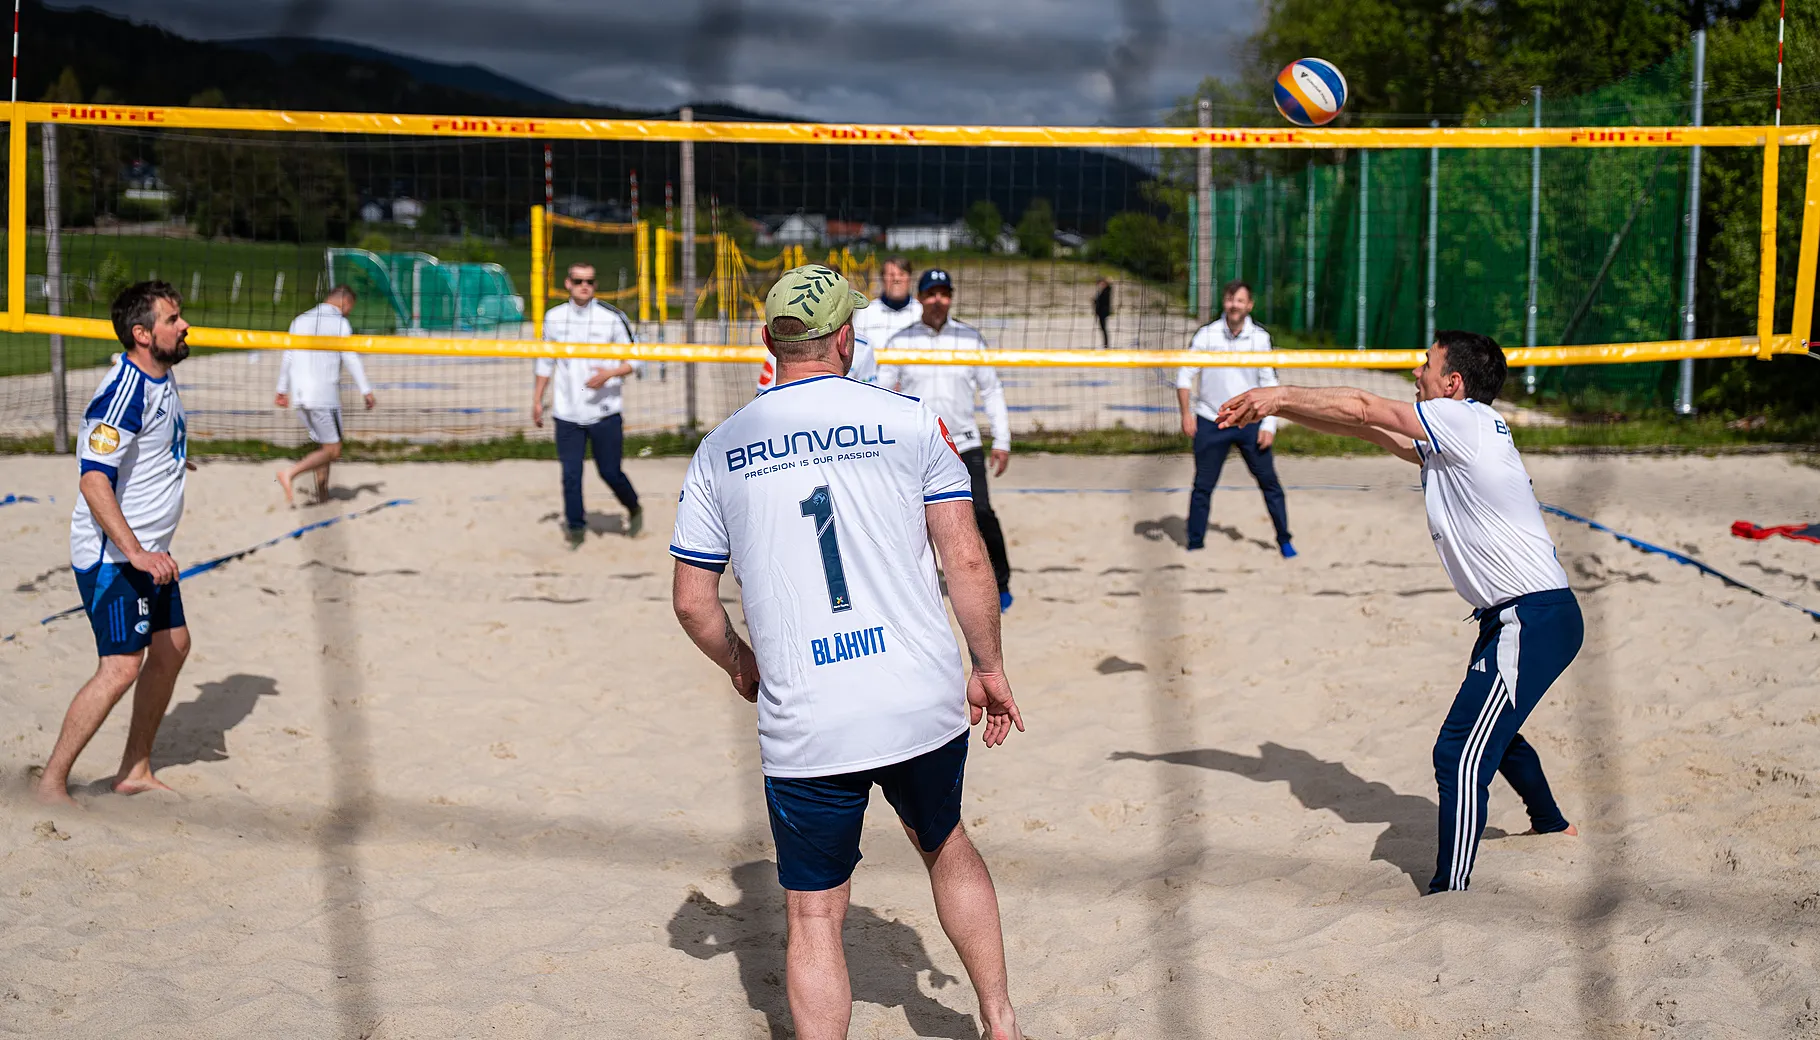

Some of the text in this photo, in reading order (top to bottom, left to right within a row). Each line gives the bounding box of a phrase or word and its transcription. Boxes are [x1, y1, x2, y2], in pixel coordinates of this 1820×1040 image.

[726, 424, 896, 472] BRUNVOLL
[744, 450, 880, 480] PRECISION IS OUR PASSION
[799, 484, 852, 614] 1
[136, 597, 149, 616] 15
[811, 626, 886, 667] BLÅHVIT
